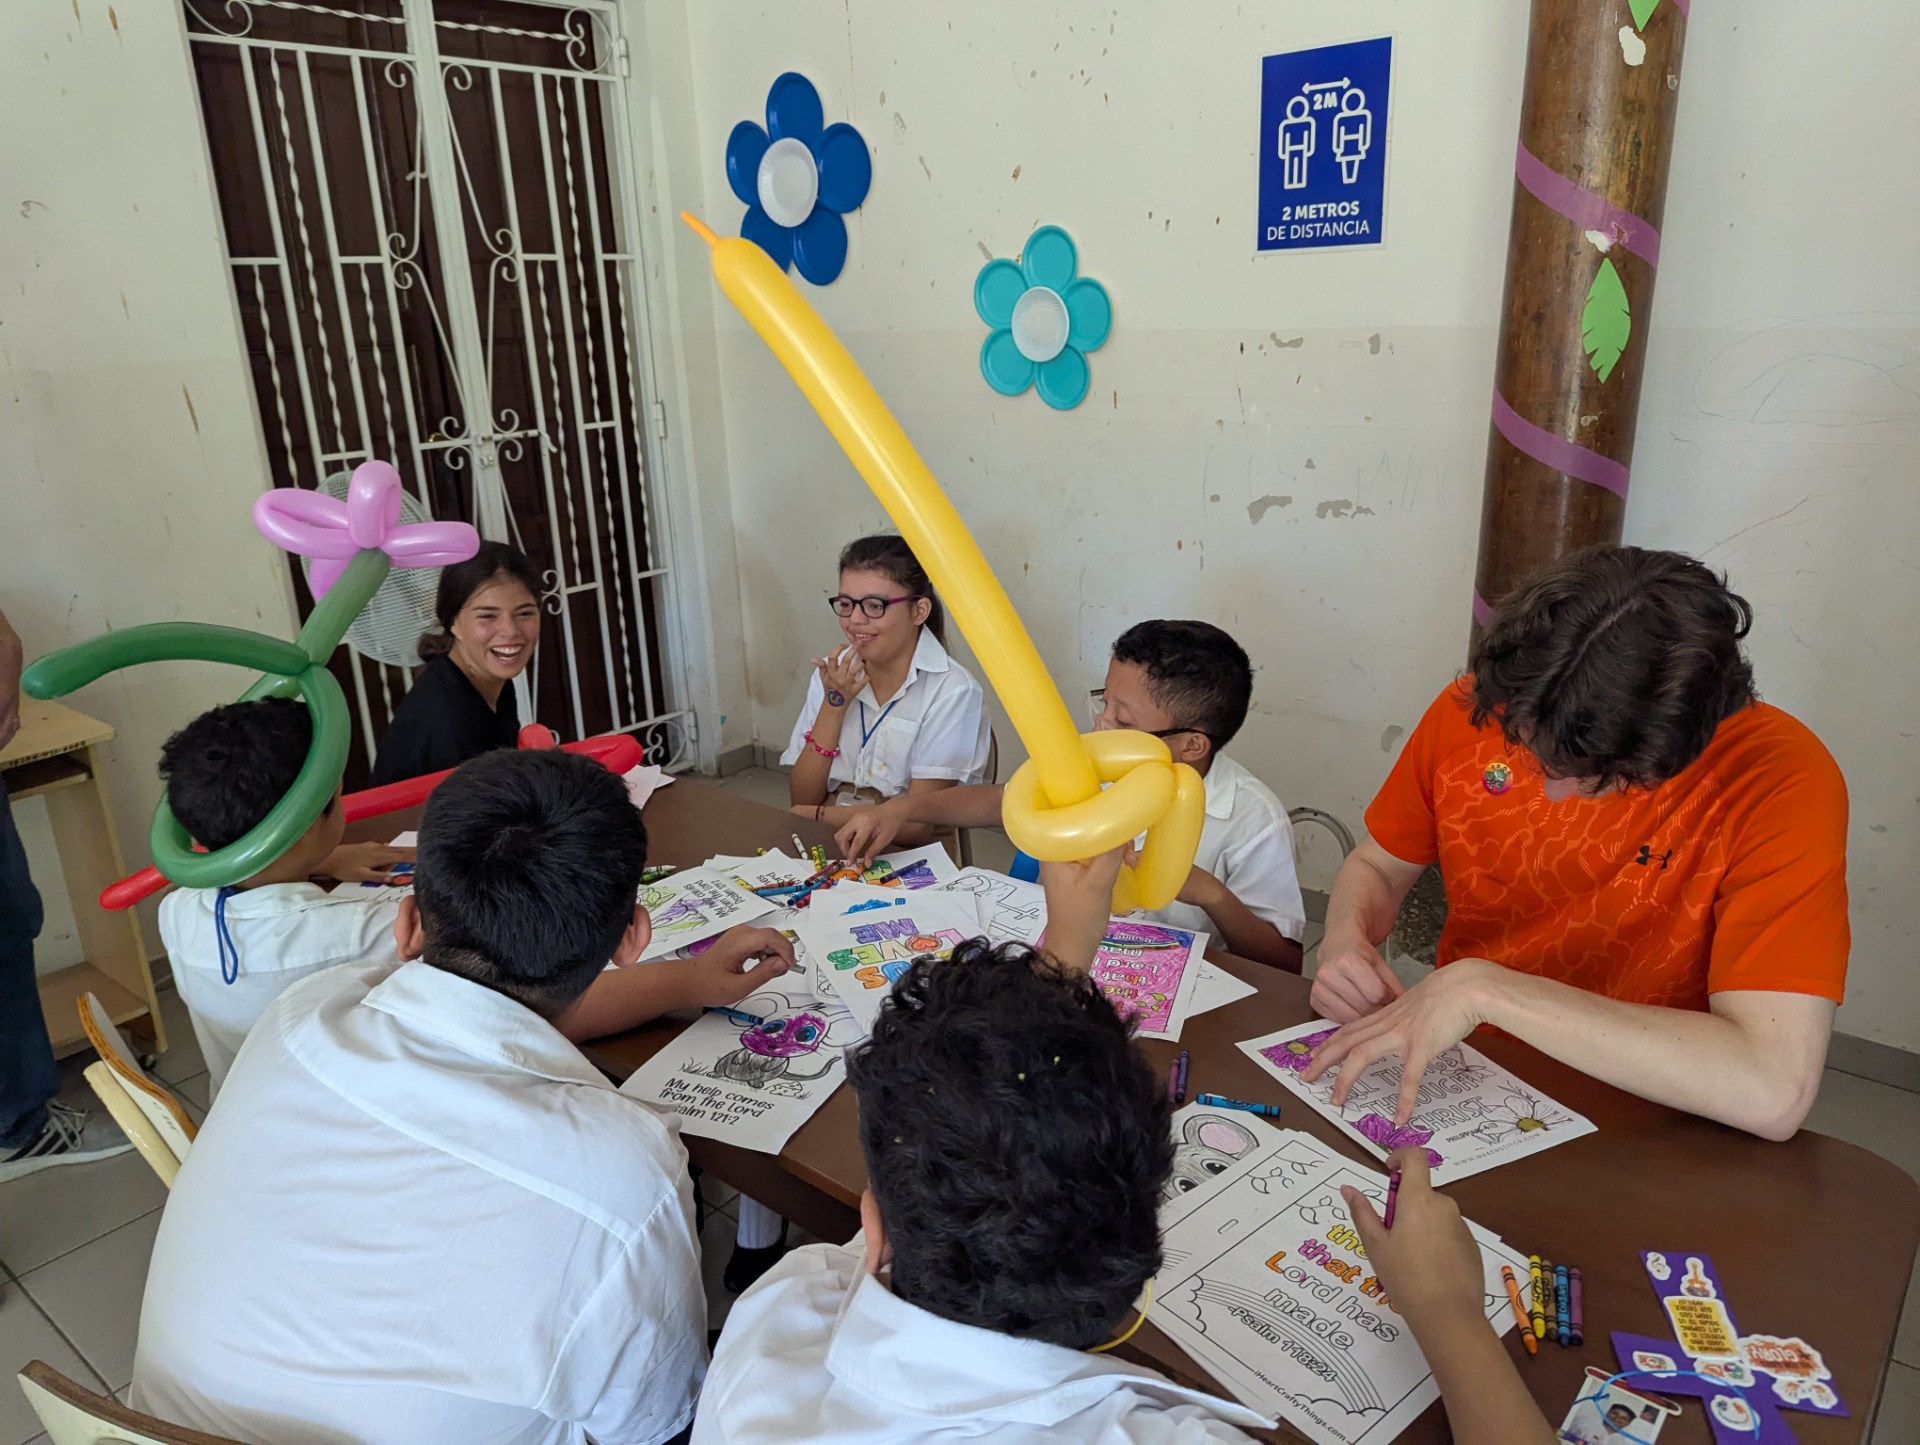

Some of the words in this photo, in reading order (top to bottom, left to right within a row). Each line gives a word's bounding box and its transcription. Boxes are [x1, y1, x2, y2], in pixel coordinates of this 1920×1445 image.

[1313, 91, 1338, 110] 2M
[1282, 207, 1291, 221] 2
[1294, 201, 1360, 219] METROS
[1267, 226, 1286, 241] DE
[1290, 220, 1370, 239] DISTANCIA
[850, 917, 919, 944] ME
[1102, 971, 1147, 986] that
[1105, 959, 1159, 974] Lord
[659, 1088, 697, 1104] from
[700, 1096, 726, 1109] the
[727, 1102, 765, 1118] Lord
[664, 1077, 691, 1092] My
[692, 1083, 722, 1097] help
[725, 1092, 775, 1110] comes
[710, 1111, 740, 1125] 121:2
[1407, 1096, 1493, 1132] CHRIST
[1298, 1238, 1363, 1285] that
[1265, 1250, 1342, 1305] Lord
[1337, 1295, 1400, 1343] has
[1263, 1288, 1355, 1351] made
[1280, 1339, 1340, 1384] 118:24
[1253, 1369, 1348, 1442] iHeartCraftyThings.com
